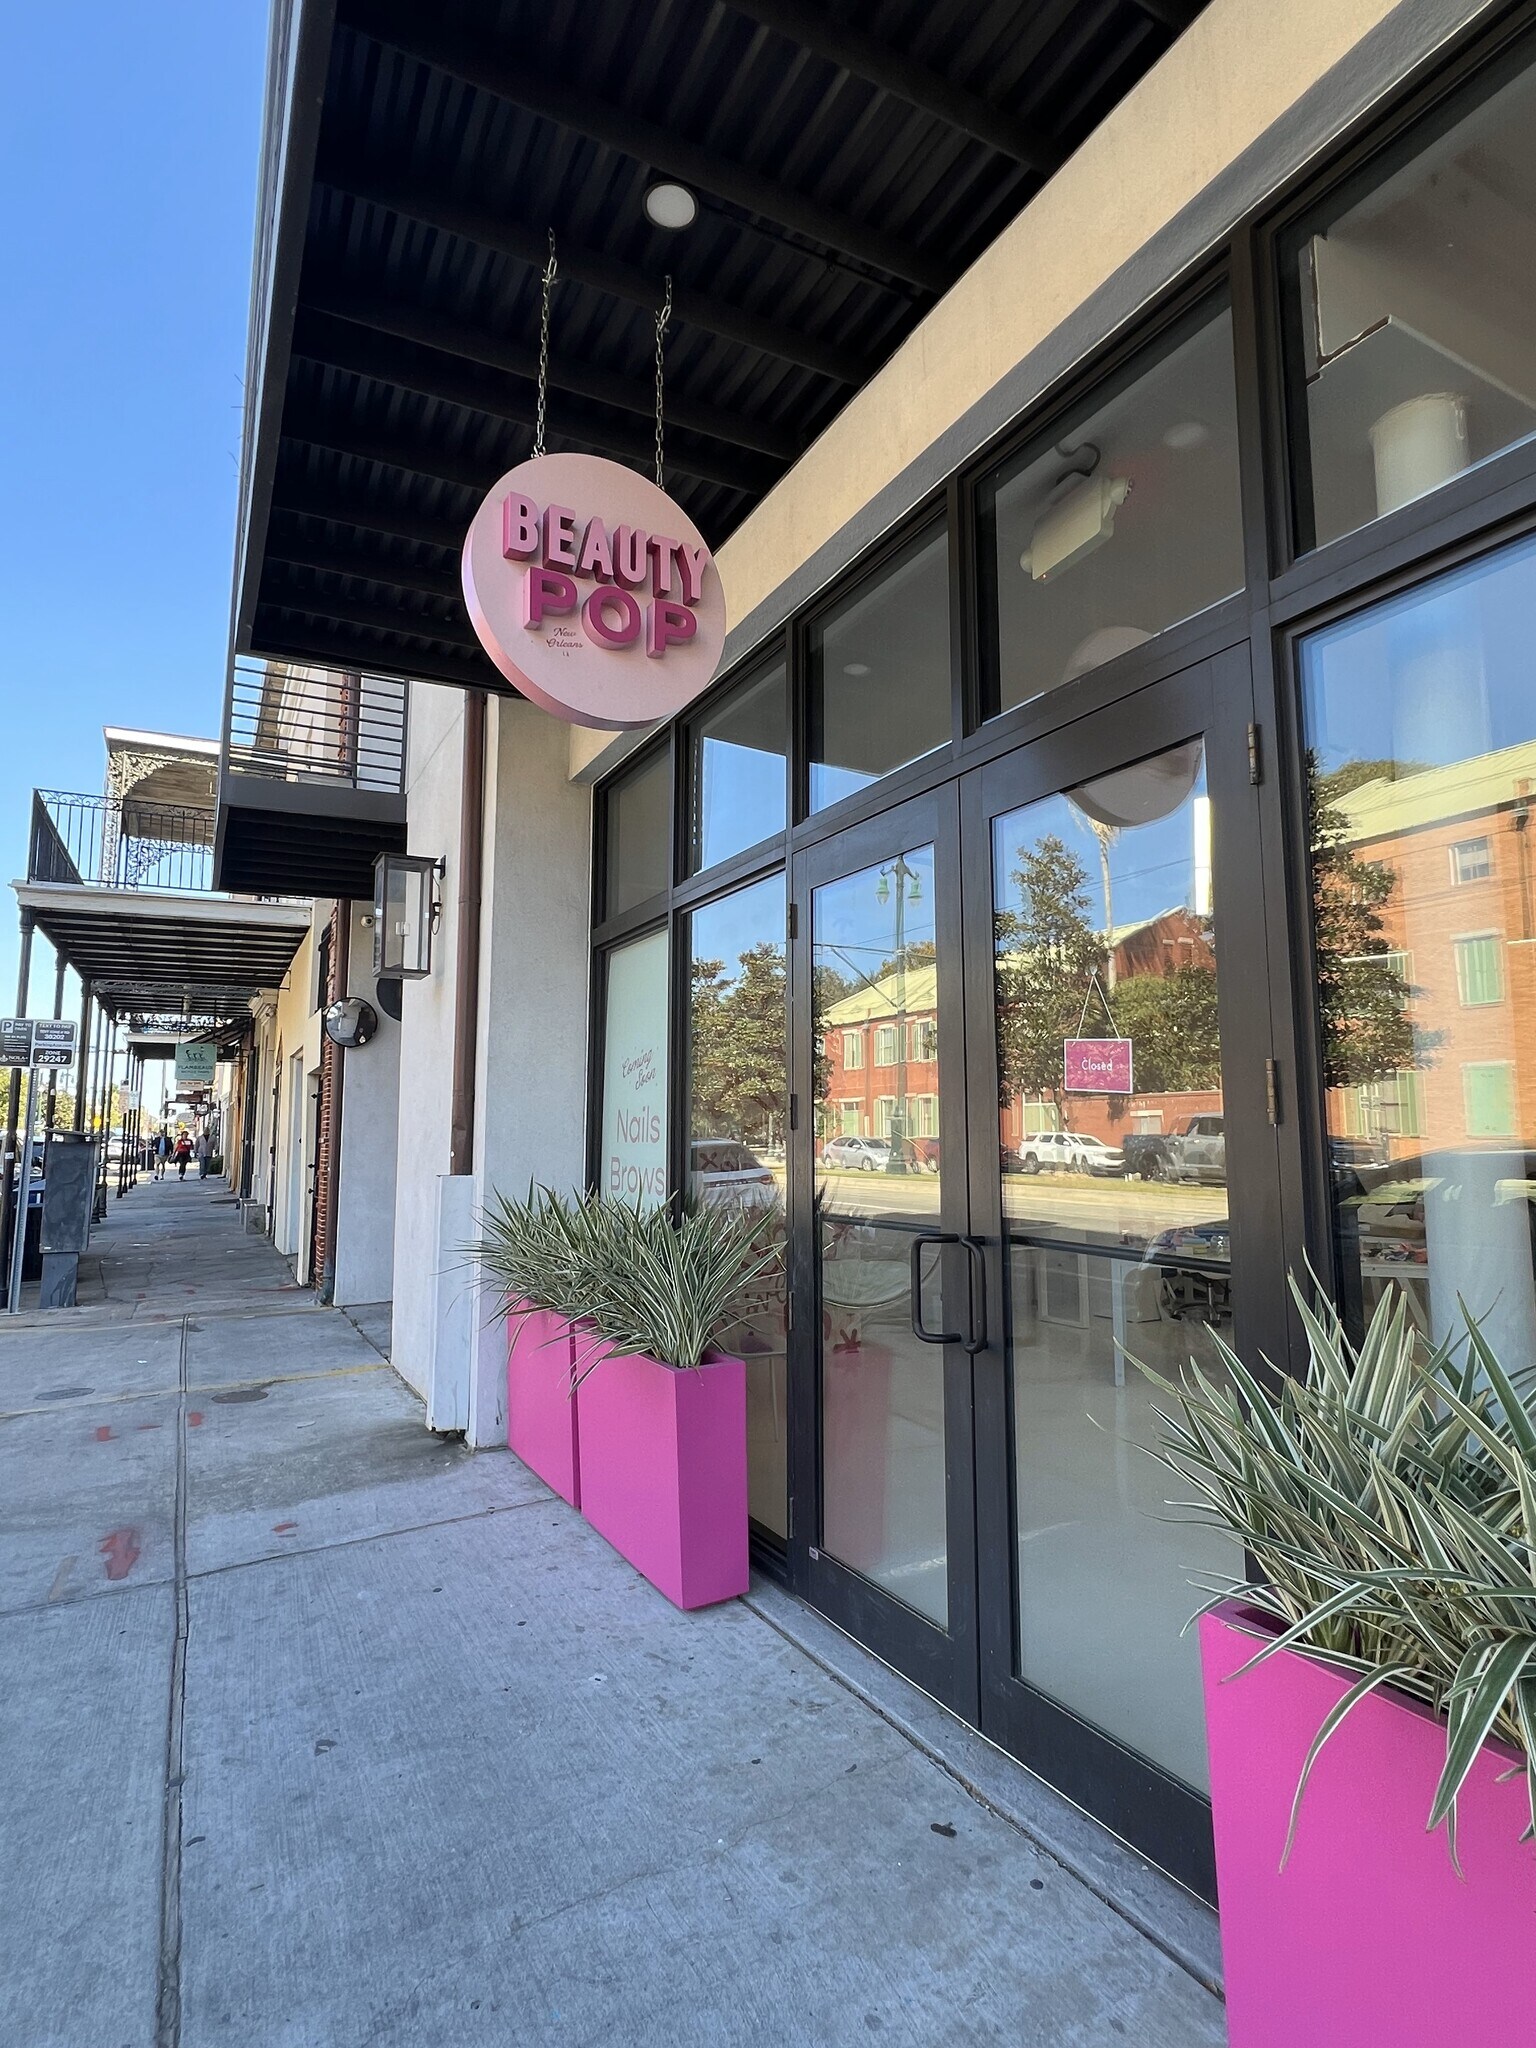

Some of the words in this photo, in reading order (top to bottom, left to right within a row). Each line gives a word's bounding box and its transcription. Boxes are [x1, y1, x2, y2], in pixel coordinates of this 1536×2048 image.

[503, 491, 709, 607] BEAUTY
[523, 567, 697, 658] POP
[546, 638, 583, 648] Orleans
[553, 627, 576, 637] New
[38, 1055, 68, 1063] 29247
[621, 1049, 653, 1079] Coming
[1081, 1058, 1113, 1071] Closed
[636, 1068, 657, 1090] Soon
[616, 1105, 661, 1144] Nails
[610, 1156, 665, 1196] Brows
